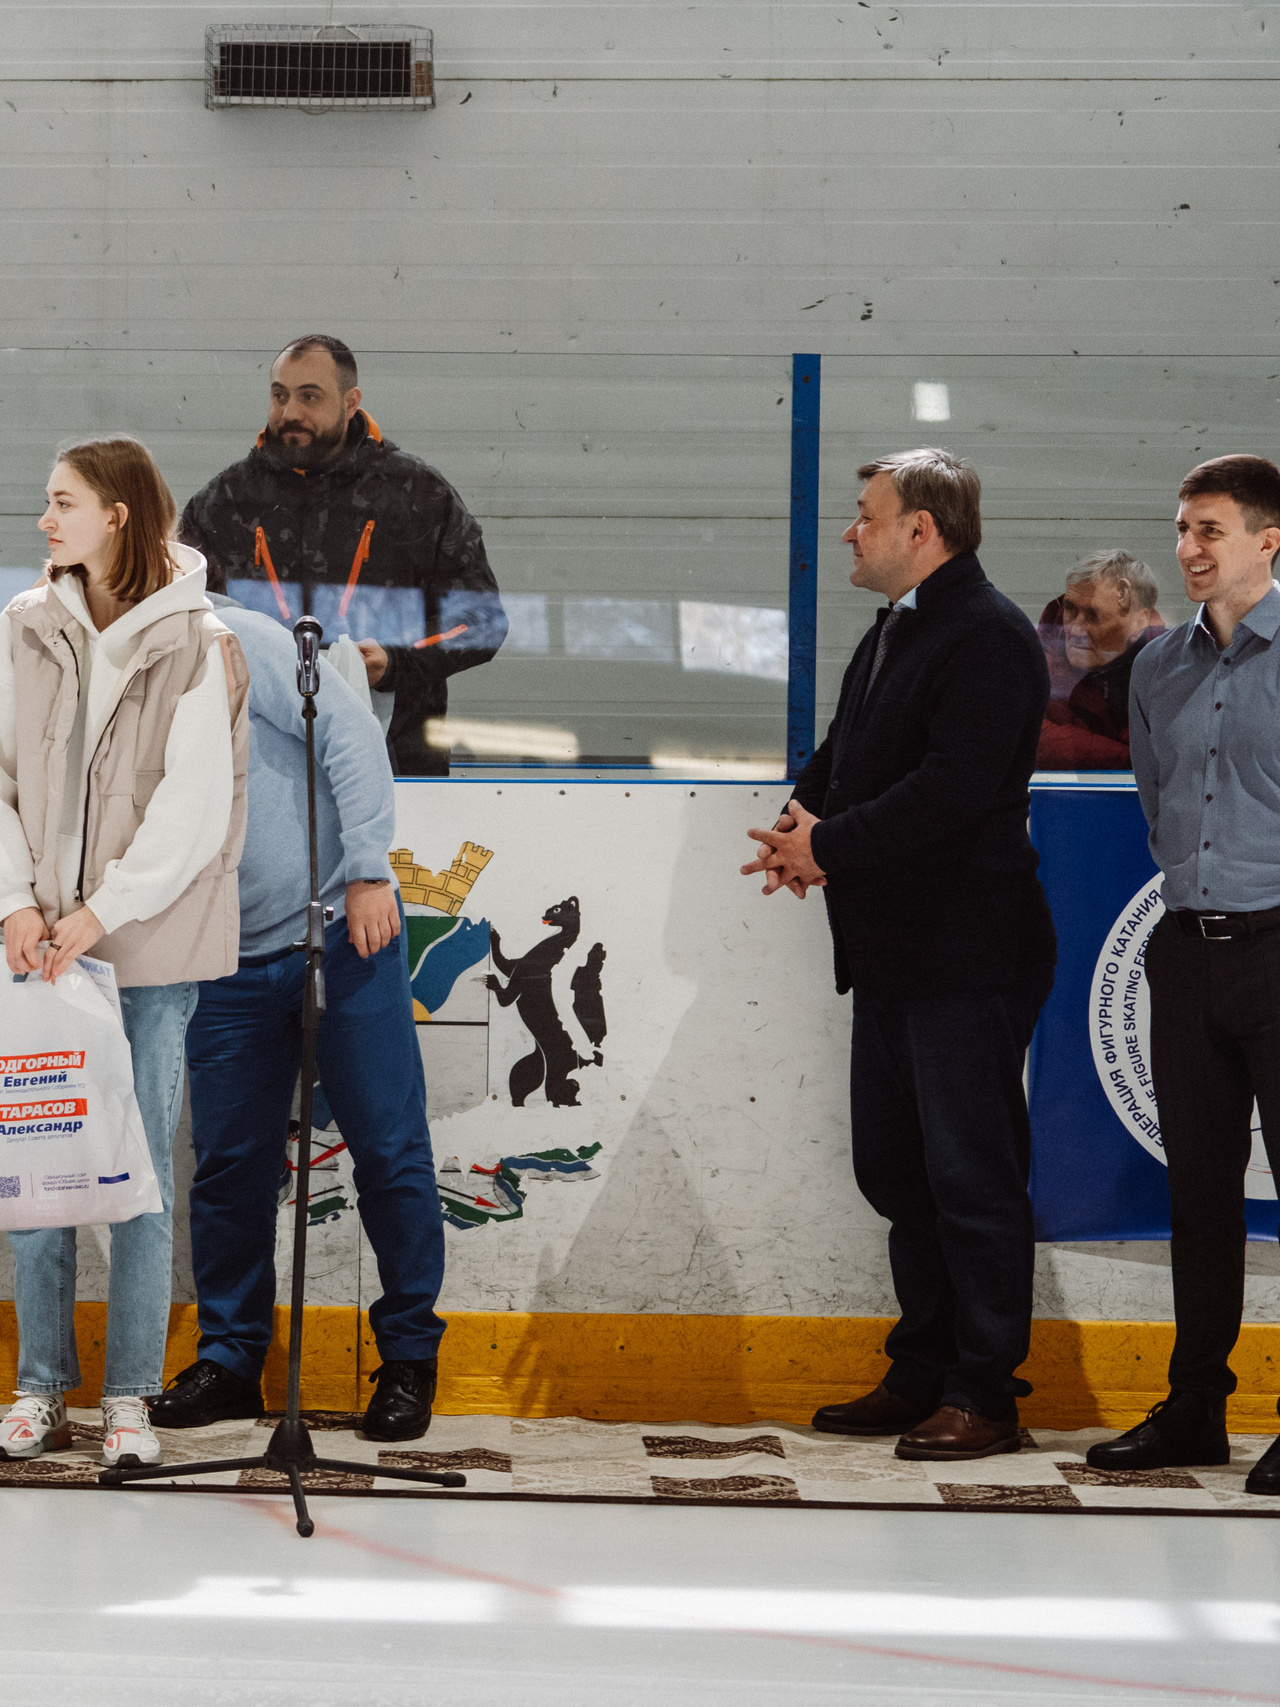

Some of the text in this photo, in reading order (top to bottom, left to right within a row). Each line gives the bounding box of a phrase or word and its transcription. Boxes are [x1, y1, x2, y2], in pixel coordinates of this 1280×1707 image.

[1098, 889, 1164, 1148] ЕДЕРАЦИЯ ФИГУРНОГО КАТАНИЯ
[1123, 969, 1141, 1031] SKATING
[3, 1071, 67, 1087] Евгений
[1125, 1034, 1152, 1087] FIGURE
[0, 1101, 76, 1119] ТАРАСОВ
